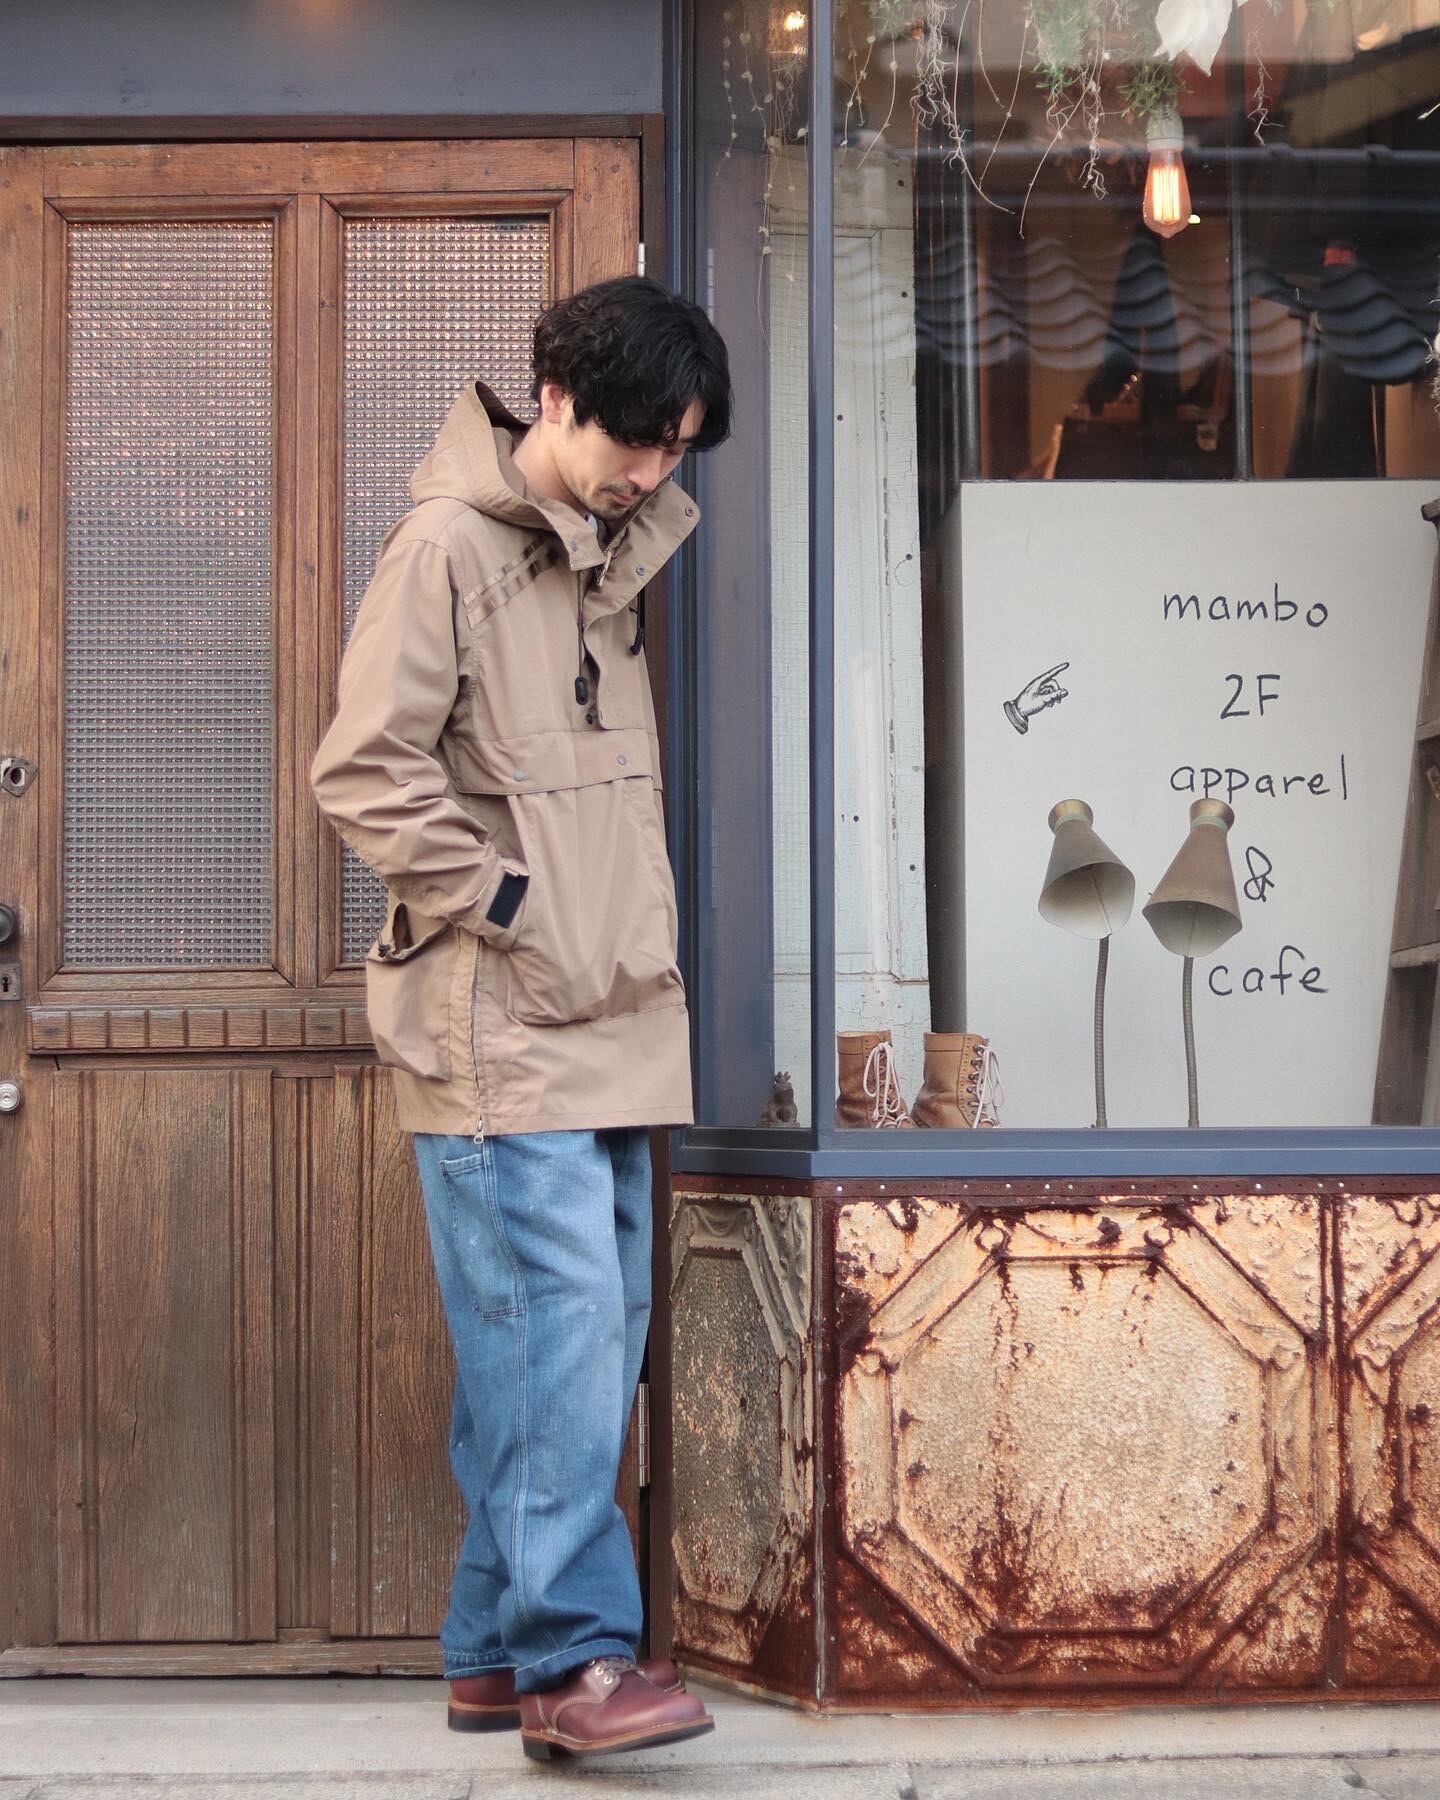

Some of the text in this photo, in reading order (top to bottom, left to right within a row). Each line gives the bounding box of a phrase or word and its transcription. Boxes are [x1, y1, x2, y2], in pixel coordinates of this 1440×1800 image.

[1163, 582, 1329, 628] mambo
[1220, 673, 1281, 720] 2F
[1170, 754, 1348, 804] apparel
[1243, 846, 1275, 903] &
[1208, 945, 1329, 996] cafe
